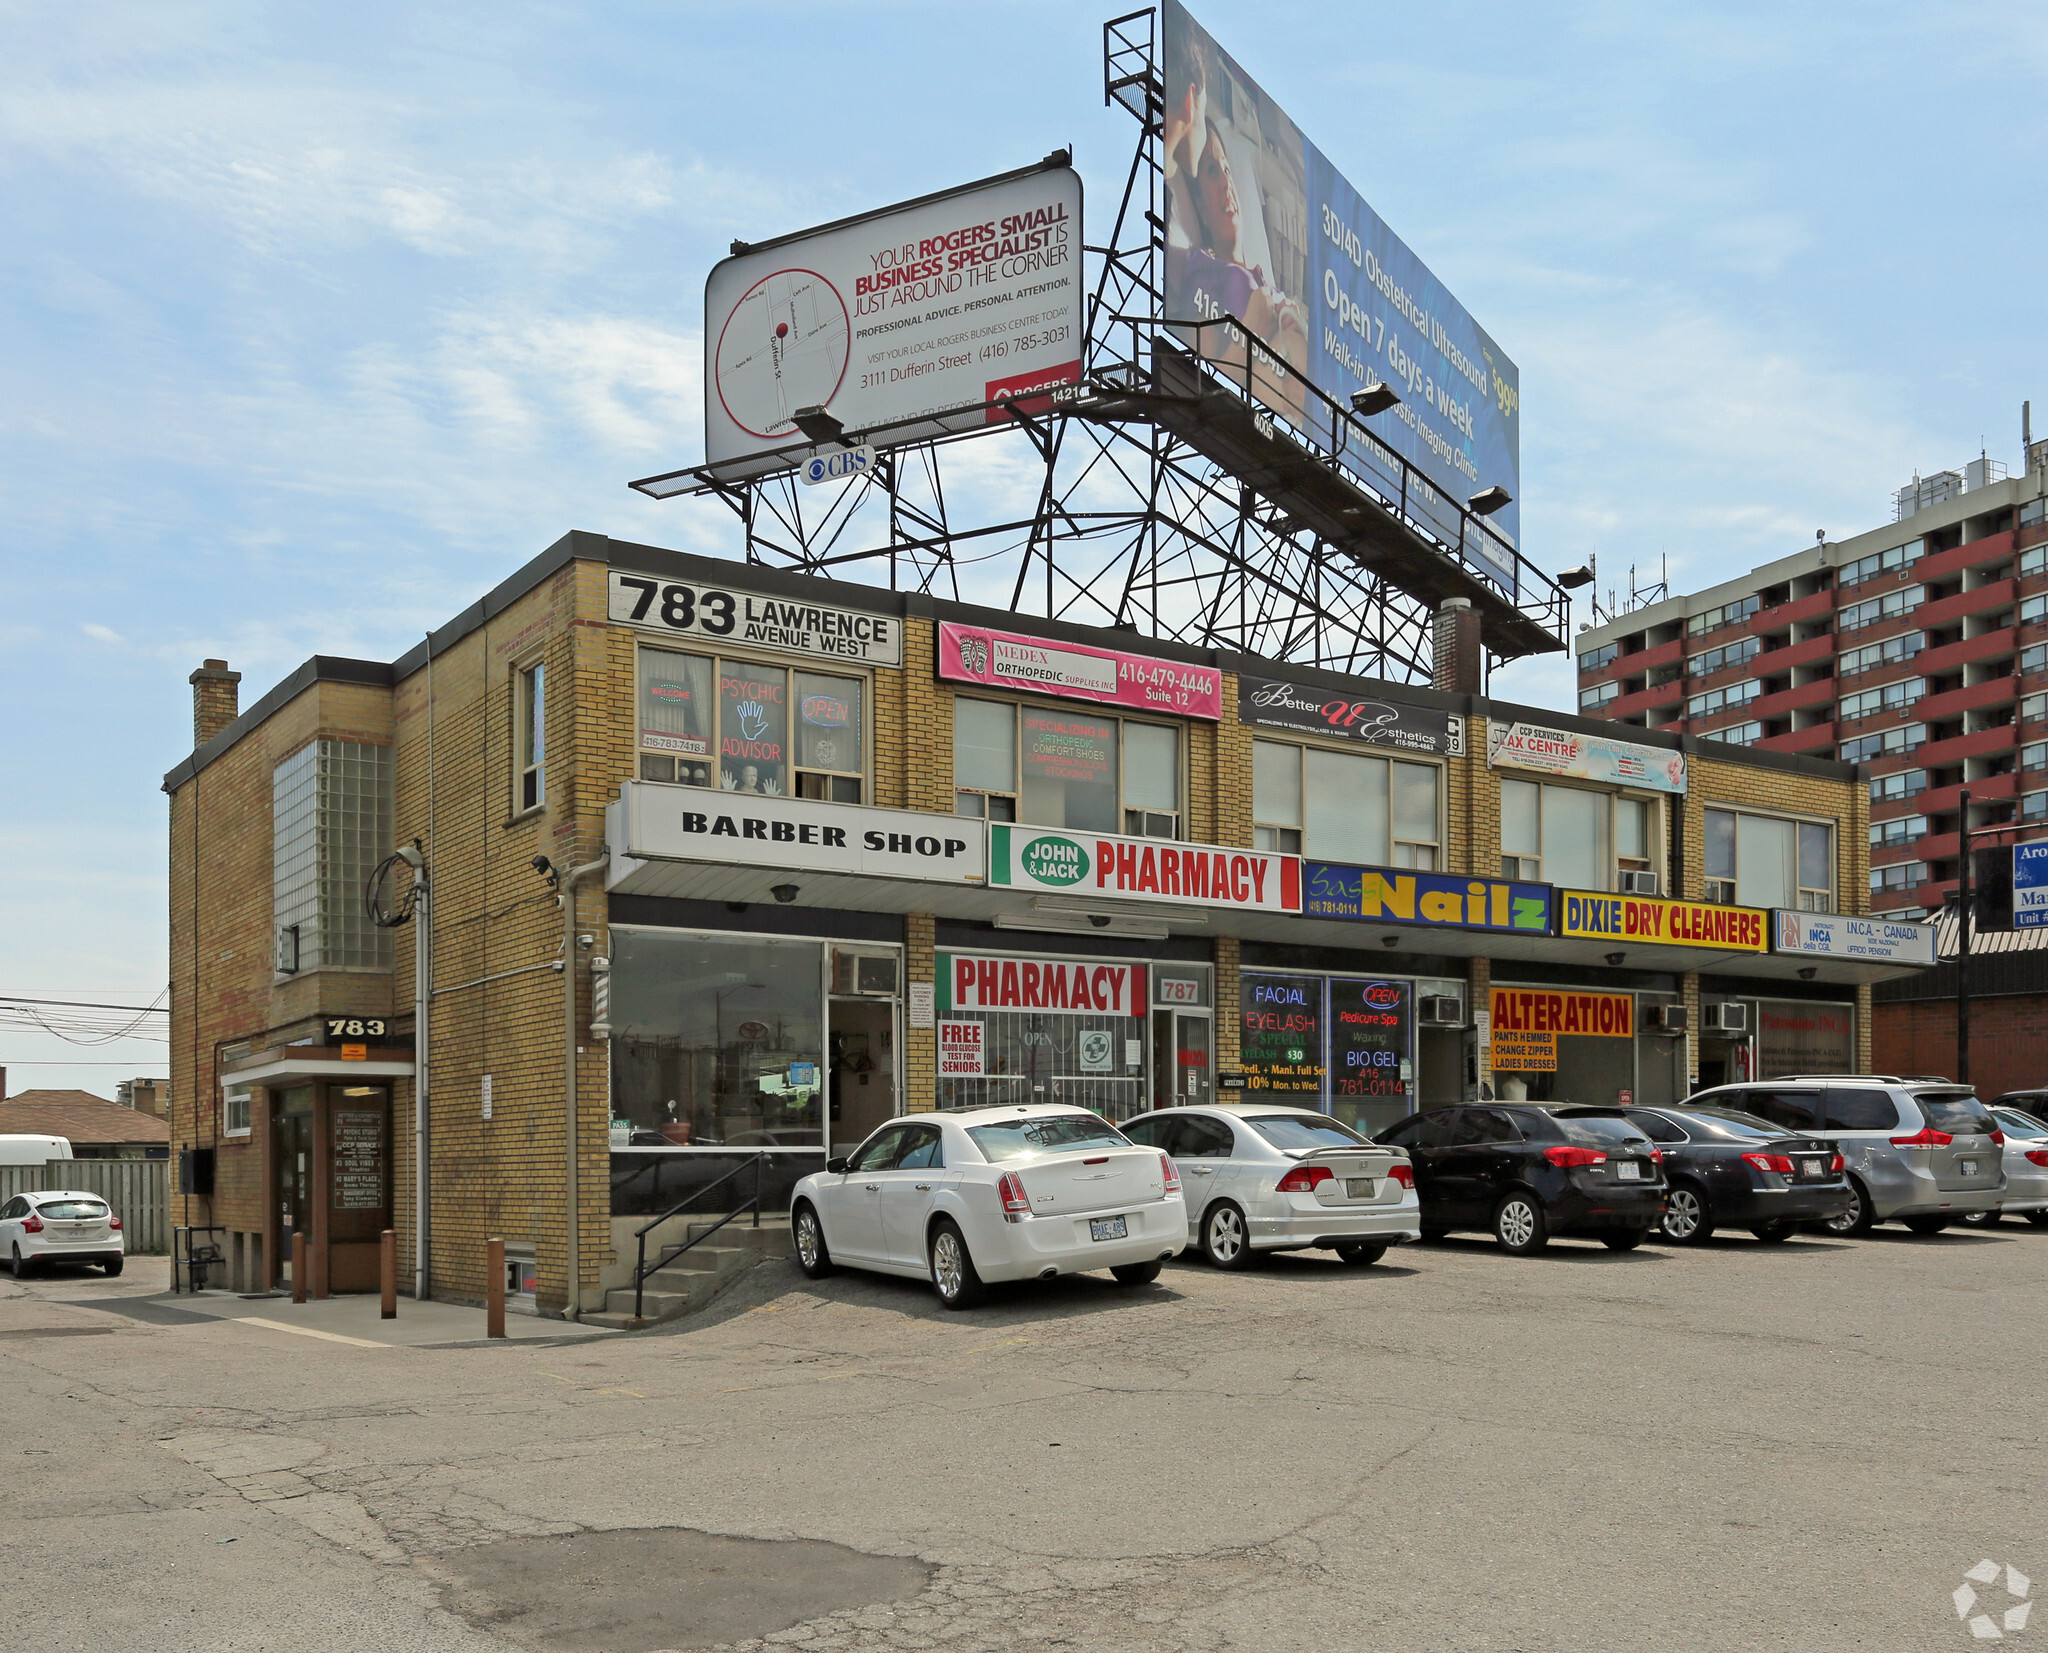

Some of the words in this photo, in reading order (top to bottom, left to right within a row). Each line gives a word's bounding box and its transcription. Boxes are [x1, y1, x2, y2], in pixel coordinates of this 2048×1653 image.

[870, 244, 915, 271] YOUR
[919, 222, 995, 259] ROGERS
[1000, 202, 1069, 235] SMALL
[856, 256, 942, 296] BUSINESS
[948, 227, 1052, 272] SPECIALIST
[1056, 222, 1068, 244] IS
[854, 291, 888, 317] JUST
[891, 272, 962, 308] AROUND
[966, 262, 997, 288] THE
[1001, 244, 1069, 278] CORNER
[856, 315, 922, 339] PROFESSIONAL
[925, 305, 962, 322] ADVICE.
[964, 292, 1013, 313] PERSONAL
[1016, 276, 1071, 300] ATTENTION.
[1322, 203, 1362, 268] 3D/4D
[1365, 249, 1429, 338] Obstetrical
[1431, 317, 1488, 397] Ultrasound
[867, 351, 886, 364] VISIT
[887, 346, 909, 359] YOUR
[910, 340, 936, 356] LOCAL
[937, 334, 969, 350] ROGERS
[970, 322, 1007, 340] BUSINESS
[1008, 314, 1040, 330] CENTRE
[1041, 305, 1070, 321] TODAY.
[770, 336, 780, 370] Dufferin
[775, 370, 782, 380] St
[860, 370, 886, 389] 3111
[890, 359, 935, 382] Dufferin
[938, 351, 972, 371] Street
[978, 340, 1009, 363] (416)
[1013, 324, 1071, 352] 785-3031
[1324, 268, 1372, 343] Open
[1374, 316, 1385, 352] 7
[1388, 333, 1423, 395] days
[1425, 375, 1434, 406] a
[1437, 386, 1475, 440] week
[1052, 386, 1078, 403] 1421
[1324, 326, 1364, 382] Walk-in
[1417, 420, 1453, 465] Imaging
[1454, 449, 1478, 482] Clinic
[1254, 412, 1274, 441] 4005
[828, 447, 867, 477] CBS
[618, 576, 737, 635] 783
[744, 597, 888, 644] LAWRENCE
[744, 623, 811, 649] AVENUE
[819, 635, 870, 657] WEST
[996, 644, 1049, 664] MEDEX
[996, 662, 1063, 682] ORTHOPEDIC
[1065, 675, 1100, 689] SUPPLIES
[1101, 680, 1115, 690] INC
[1119, 662, 1213, 696] 416-479-4446
[651, 686, 690, 701] WELCOME
[720, 677, 782, 704] PSYCHIC
[1145, 686, 1172, 703] Suite
[1175, 690, 1189, 705] 12
[803, 698, 849, 721] OPEN
[1251, 683, 1321, 712] Better
[1351, 701, 1436, 744] Esthetics
[1025, 718, 1096, 737] SPECIALIZING
[1519, 726, 1533, 737] CCP
[1533, 729, 1565, 742] SERVICES
[721, 737, 782, 761] ADVISOR
[1039, 734, 1094, 749] ORTHOPEDIC
[1527, 738, 1577, 758] CENTRE
[1033, 743, 1075, 756] COMFORT
[1076, 748, 1105, 761] SHOES
[682, 811, 847, 848] BARBER
[863, 830, 967, 858] SHOP
[1029, 842, 1079, 863] JOHN
[1038, 862, 1080, 880] JACK
[1096, 840, 1268, 904] PHARMACY
[1361, 871, 1547, 930] Nailz
[1567, 896, 1622, 934] DIXIE
[1625, 902, 1664, 937] DRY
[1670, 905, 1761, 947] CLEANERS
[2020, 912, 2039, 924] Unit
[1809, 929, 1831, 943] INCA
[1883, 925, 1918, 941] CANADA
[1803, 943, 1816, 951] della
[1818, 943, 1831, 951] CGIL
[1847, 946, 1867, 954] UFFICIO
[1868, 947, 1892, 956] PENSIONI
[957, 958, 1127, 1011] PHARMACY
[1163, 981, 1197, 1000] 787
[1255, 986, 1308, 1006] FACIAL
[1364, 988, 1400, 1002] OPEN
[1246, 1012, 1315, 1032] EYELASH
[1340, 1011, 1379, 1024] Pedicure
[1380, 1013, 1398, 1027] Spa
[1493, 991, 1629, 1034] ALTERATION
[328, 1019, 385, 1036] 783
[1819, 1015, 1849, 1033] INCA
[942, 1024, 981, 1044] FREE
[1024, 1031, 1052, 1047] OPEN
[1259, 1033, 1307, 1046] SPECIAL
[1353, 1032, 1387, 1045] Waxing
[1495, 1031, 1518, 1042] PANTS
[1520, 1032, 1552, 1043] HEMMED
[942, 1043, 958, 1052] BLOOD
[959, 1044, 981, 1052] GLUCOSE
[947, 1052, 962, 1060] TEST
[1288, 1050, 1303, 1061] $30
[1495, 1045, 1526, 1055] CHANGE
[1528, 1046, 1553, 1056] ZIPPER
[942, 1061, 981, 1073] SENIORS
[1347, 1051, 1370, 1066] BIO
[1373, 1051, 1398, 1067] GEL
[1495, 1058, 1522, 1068] LADIES
[1523, 1059, 1556, 1069] DRESSES
[1239, 1064, 1261, 1075] Pedi.
[1271, 1065, 1295, 1076] Mani.
[1297, 1066, 1312, 1076] Full
[1313, 1066, 1328, 1076] Set
[1359, 1068, 1379, 1079] 416
[1247, 1075, 1270, 1090] 10%
[1273, 1080, 1291, 1090] Mon.
[1292, 1081, 1300, 1090] to
[1301, 1080, 1320, 1091] Wed.
[1339, 1079, 1403, 1095] 781-0114
